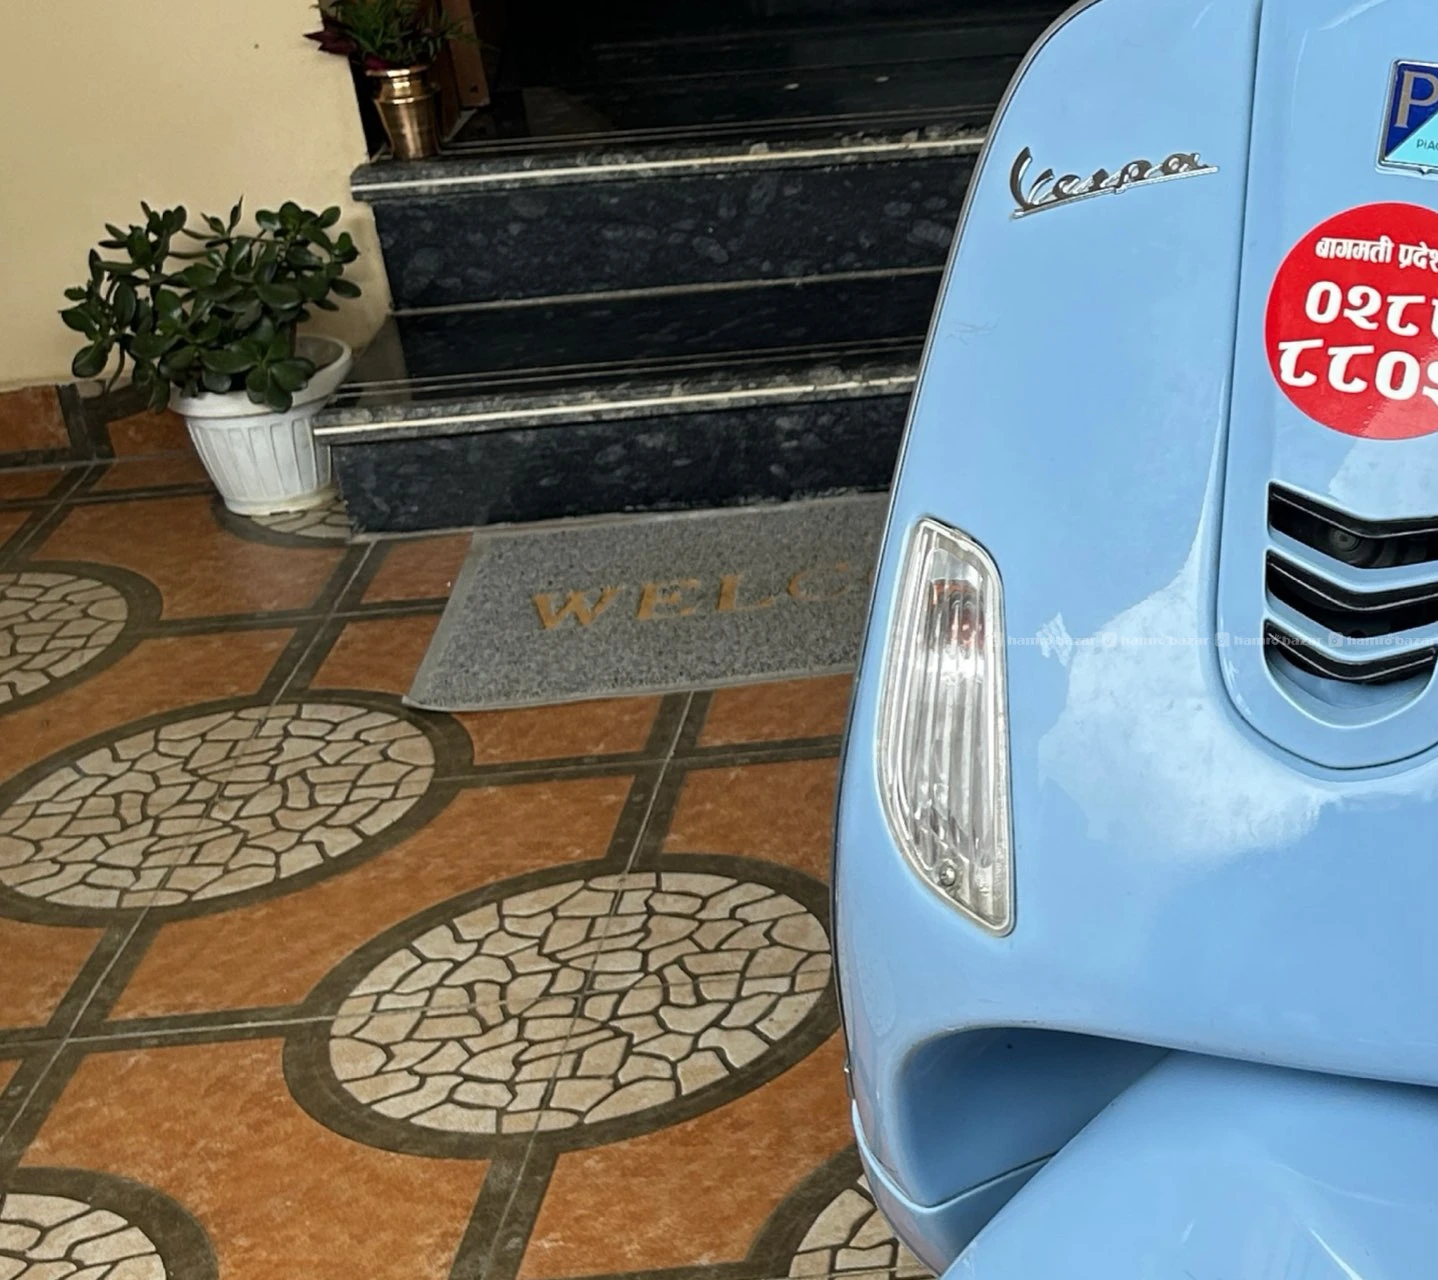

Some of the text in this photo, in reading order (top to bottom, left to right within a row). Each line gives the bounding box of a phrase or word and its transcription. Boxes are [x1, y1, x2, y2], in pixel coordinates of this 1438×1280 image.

[1009, 146, 1216, 217] Vespa
[1315, 234, 1395, 264] बागमती
[531, 562, 874, 631] WELC
